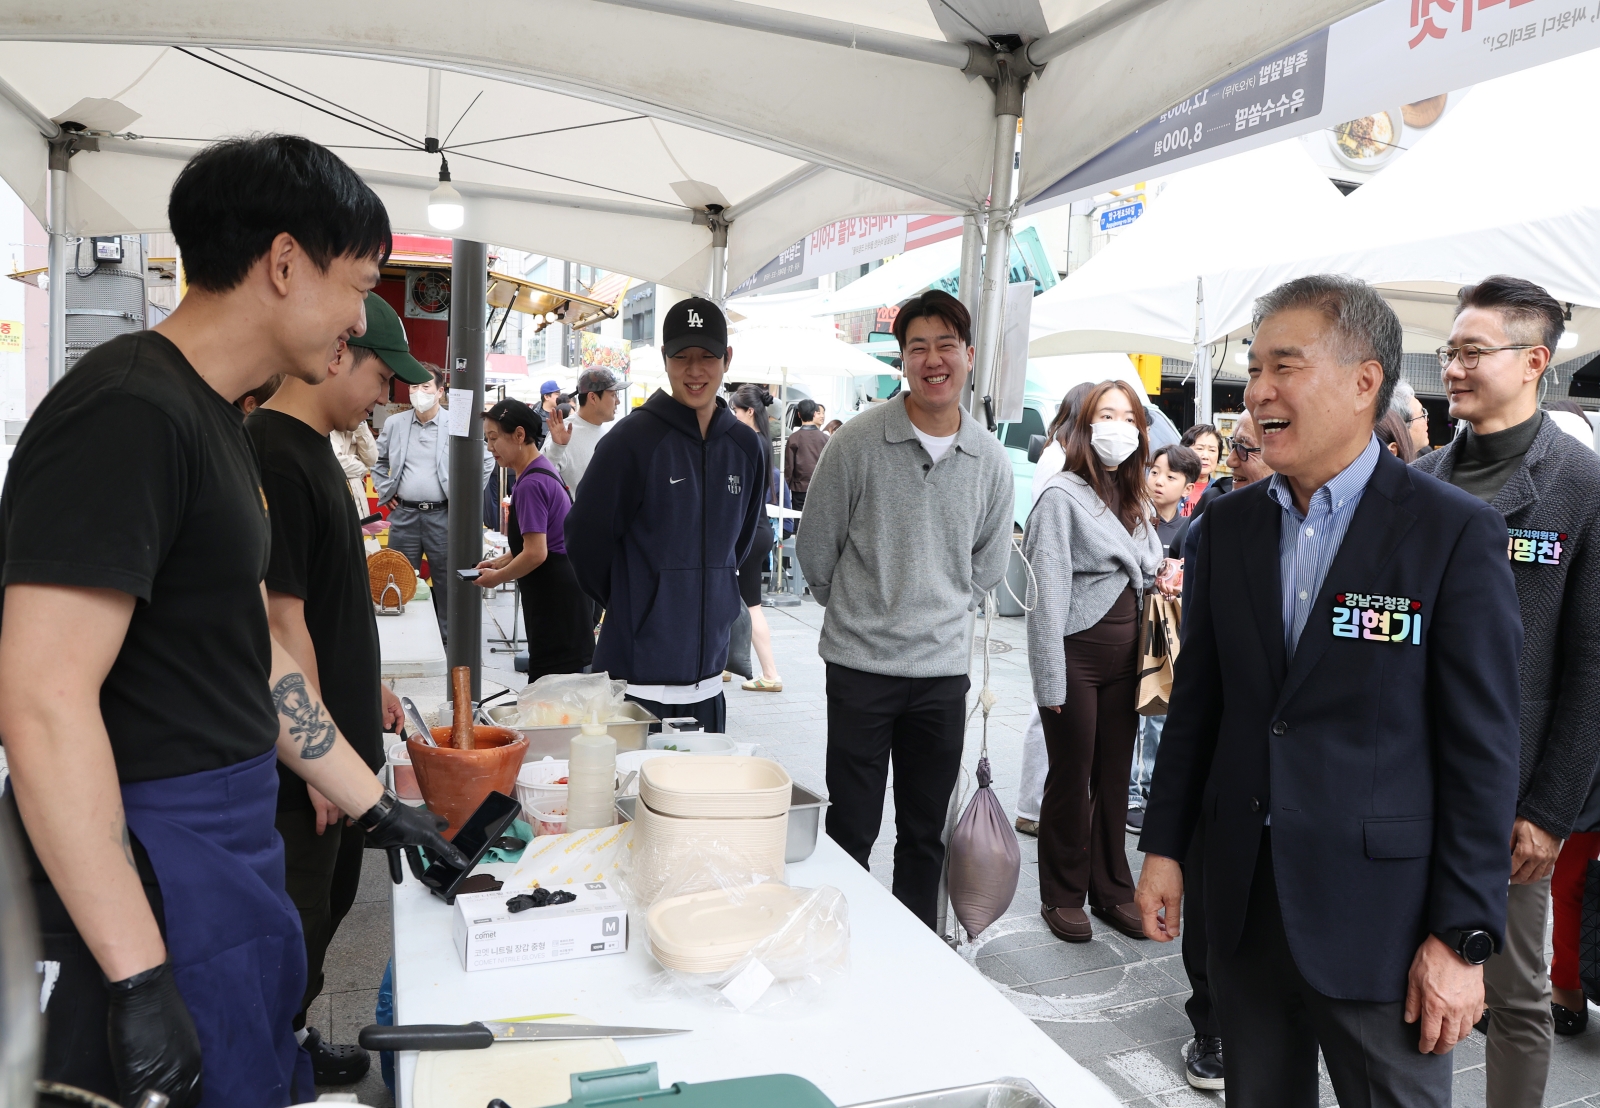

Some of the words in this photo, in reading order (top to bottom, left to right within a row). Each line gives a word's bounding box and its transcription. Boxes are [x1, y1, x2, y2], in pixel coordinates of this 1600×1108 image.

[687, 309, 704, 328] LA
[1345, 592, 1411, 612] 강남구청장
[1332, 606, 1422, 645] 김현기
[605, 921, 616, 932] M
[475, 931, 496, 940] comet
[474, 948, 490, 957] 코멧
[490, 945, 513, 956] 니트릴
[514, 943, 530, 953] 장갑
[531, 941, 546, 952] 중형
[473, 957, 497, 967] COMET
[497, 954, 521, 964] NITRILE
[521, 952, 546, 961] GLOVES
